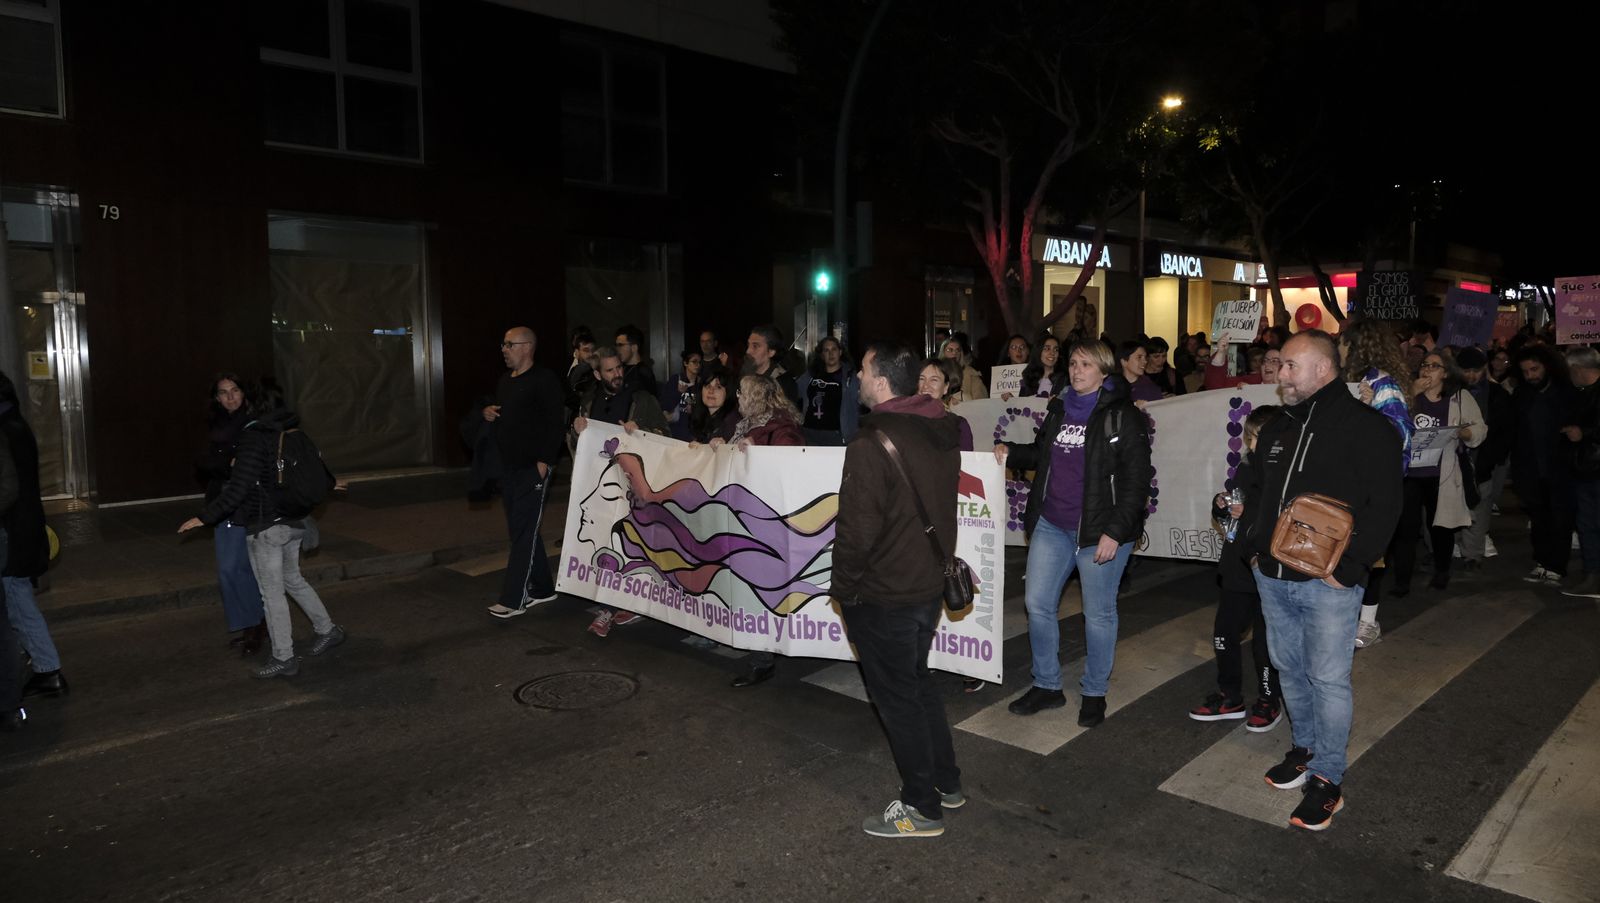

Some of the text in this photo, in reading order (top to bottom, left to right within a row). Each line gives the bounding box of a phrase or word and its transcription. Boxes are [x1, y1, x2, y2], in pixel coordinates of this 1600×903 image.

[99, 204, 120, 220] 79
[1043, 238, 1112, 268] ABANA
[1372, 272, 1409, 284] SOMOS
[1368, 284, 1408, 296] EL GRITO
[1561, 282, 1585, 294] que
[1231, 300, 1260, 314] CUERPO
[1378, 296, 1397, 308] LAS
[1001, 368, 1021, 379] GIRL
[996, 380, 1021, 390] POWE
[957, 501, 992, 519] TEA
[963, 518, 996, 529] FEMINISTA
[975, 533, 995, 633] Almería
[567, 556, 593, 583] Por
[595, 569, 623, 592] una
[623, 576, 683, 610] sociedad
[684, 596, 699, 616] en
[701, 595, 769, 635] igualdad
[775, 616, 786, 643] y
[788, 613, 842, 643] libre
